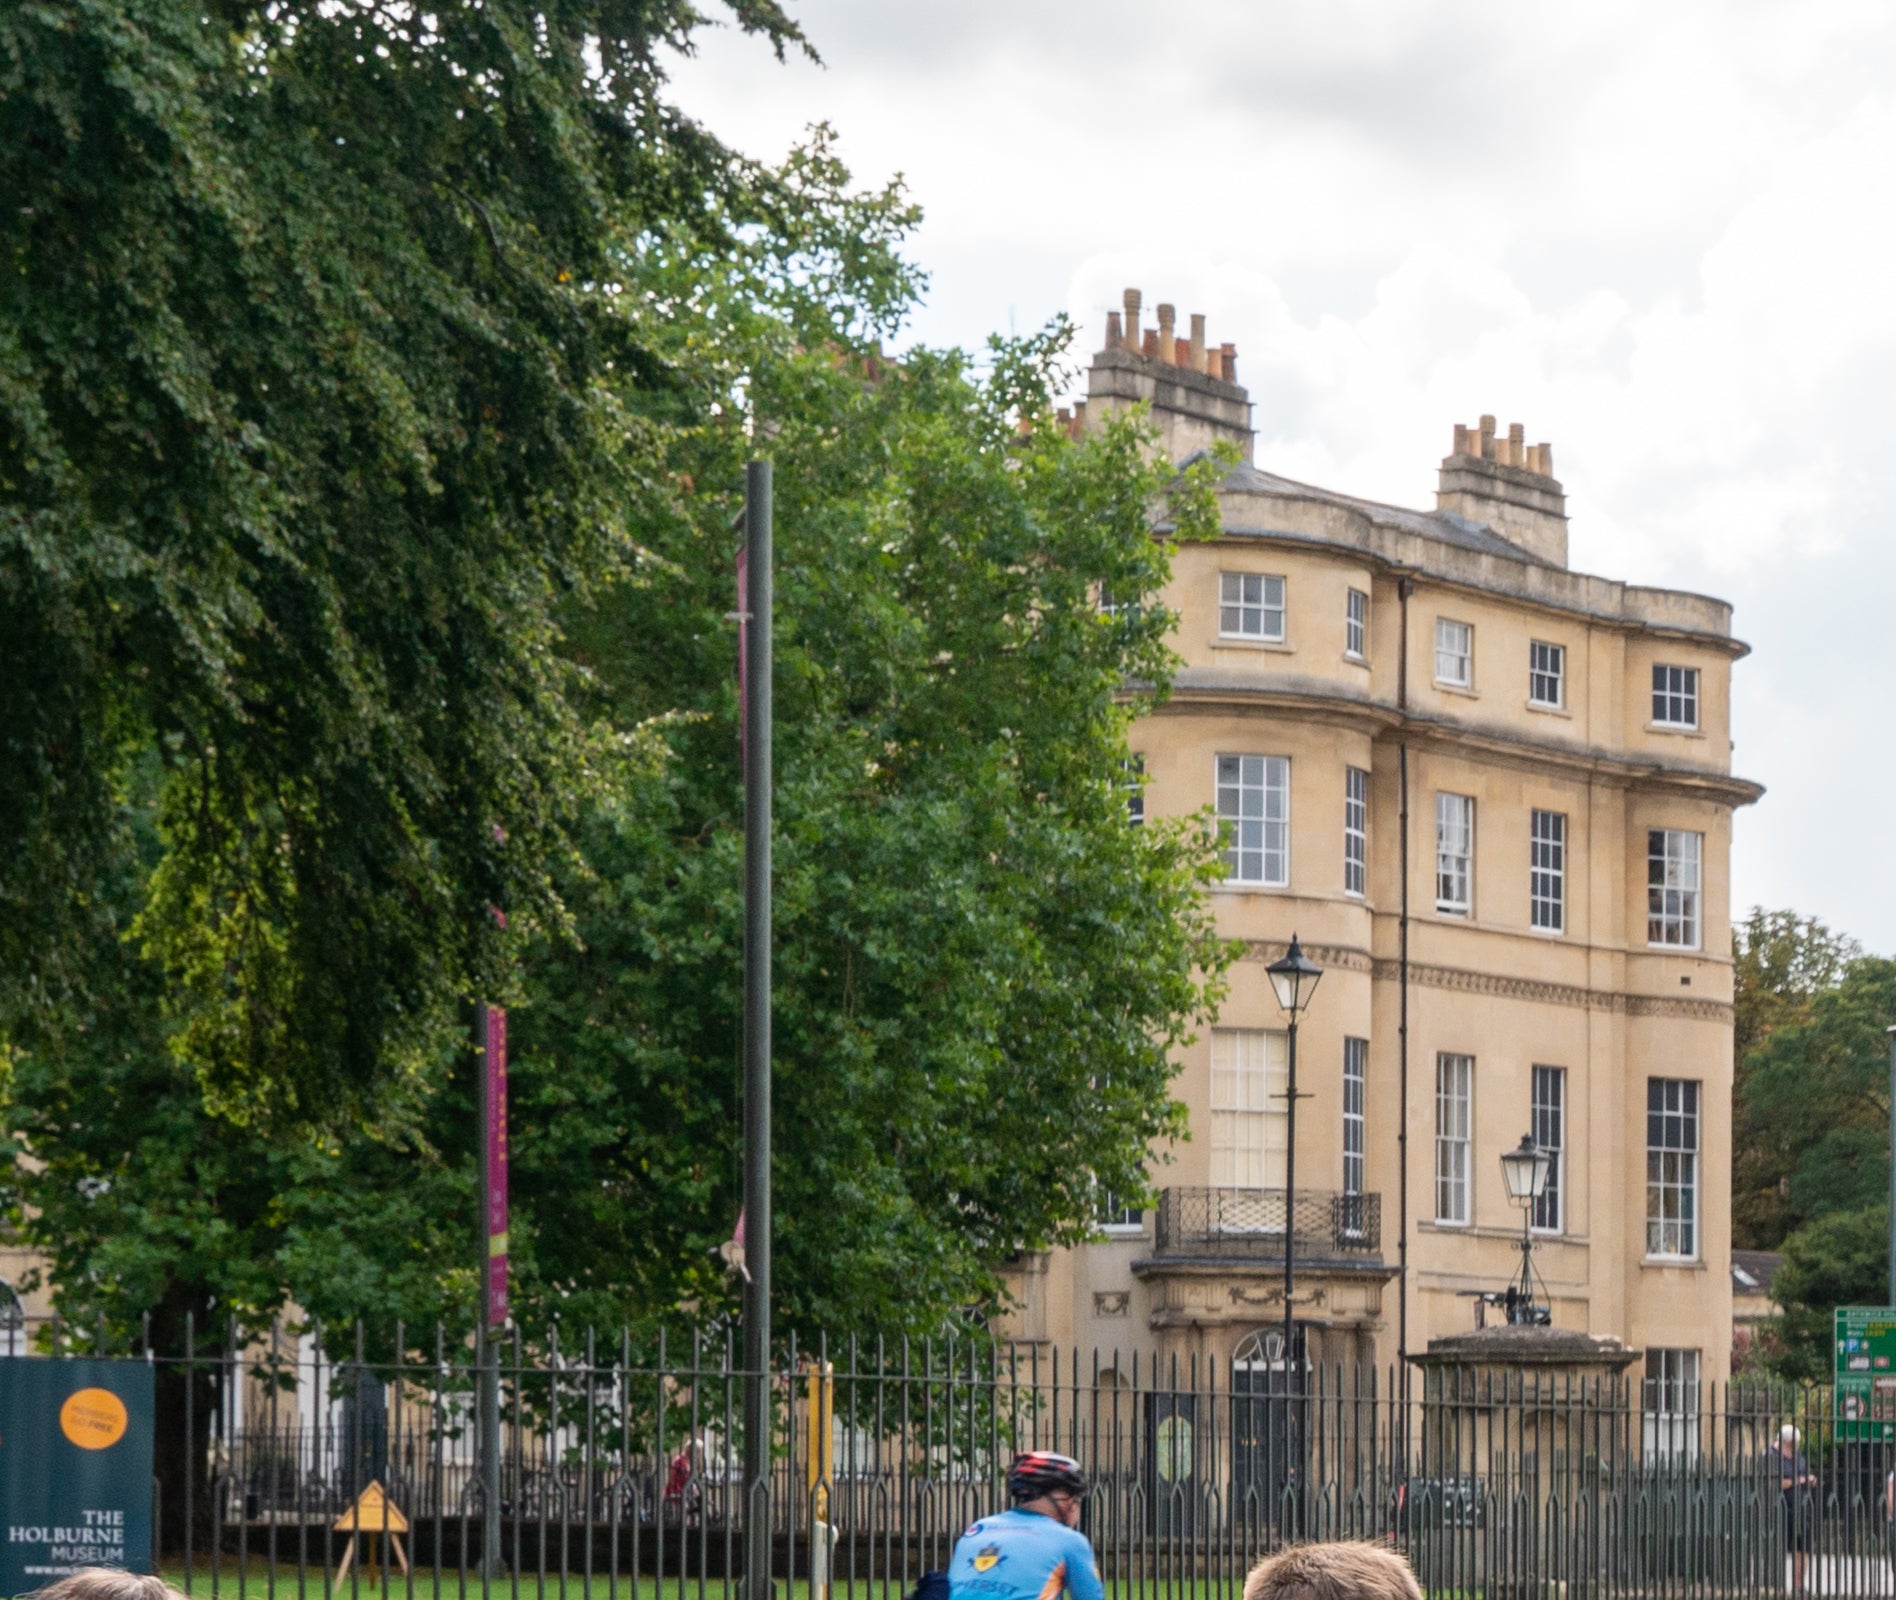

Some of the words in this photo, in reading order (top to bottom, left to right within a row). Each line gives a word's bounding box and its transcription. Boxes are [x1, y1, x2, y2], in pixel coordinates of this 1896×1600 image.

[82, 1510, 124, 1525] THE
[9, 1526, 124, 1544] HOLBURNE
[51, 1545, 124, 1561] MUSEUM
